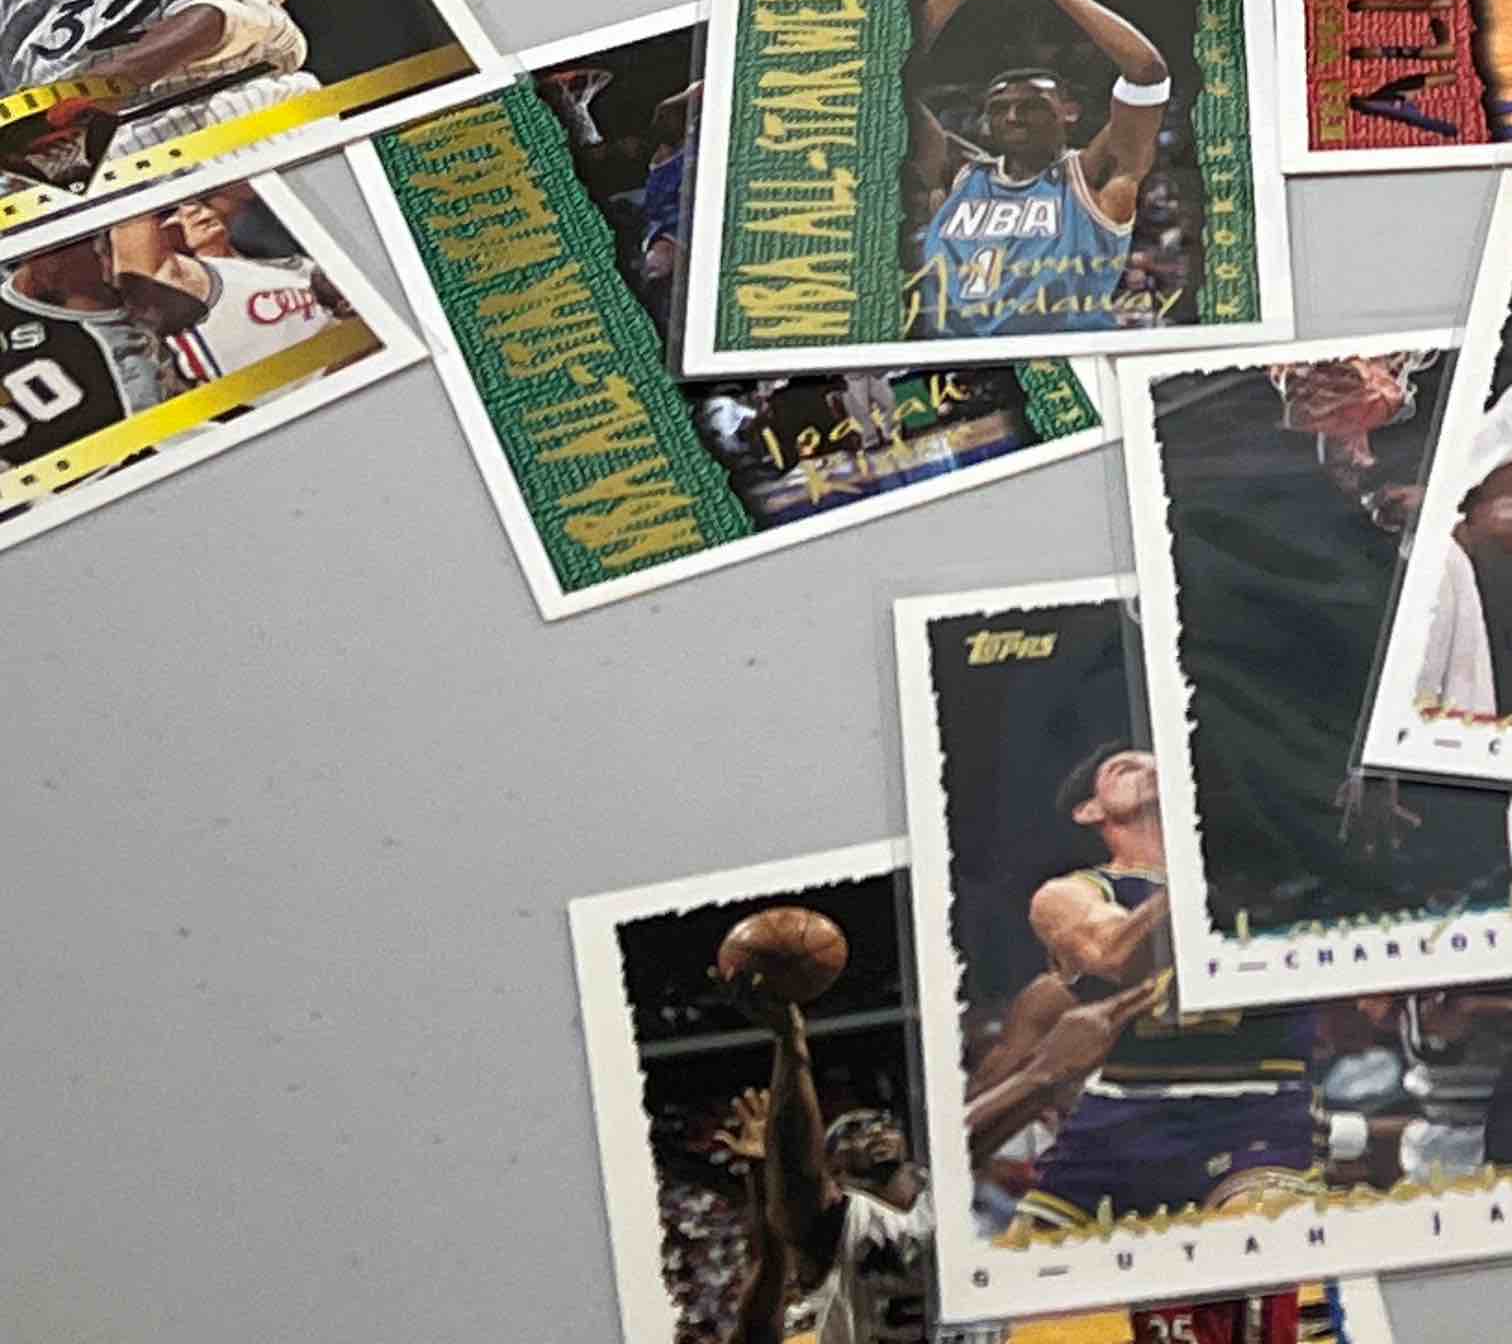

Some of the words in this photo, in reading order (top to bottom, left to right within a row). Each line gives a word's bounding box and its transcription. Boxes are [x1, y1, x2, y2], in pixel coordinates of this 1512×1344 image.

[941, 197, 1061, 240] NBA
[960, 247, 997, 300] 1
[903, 285, 1184, 338] Hardaway
